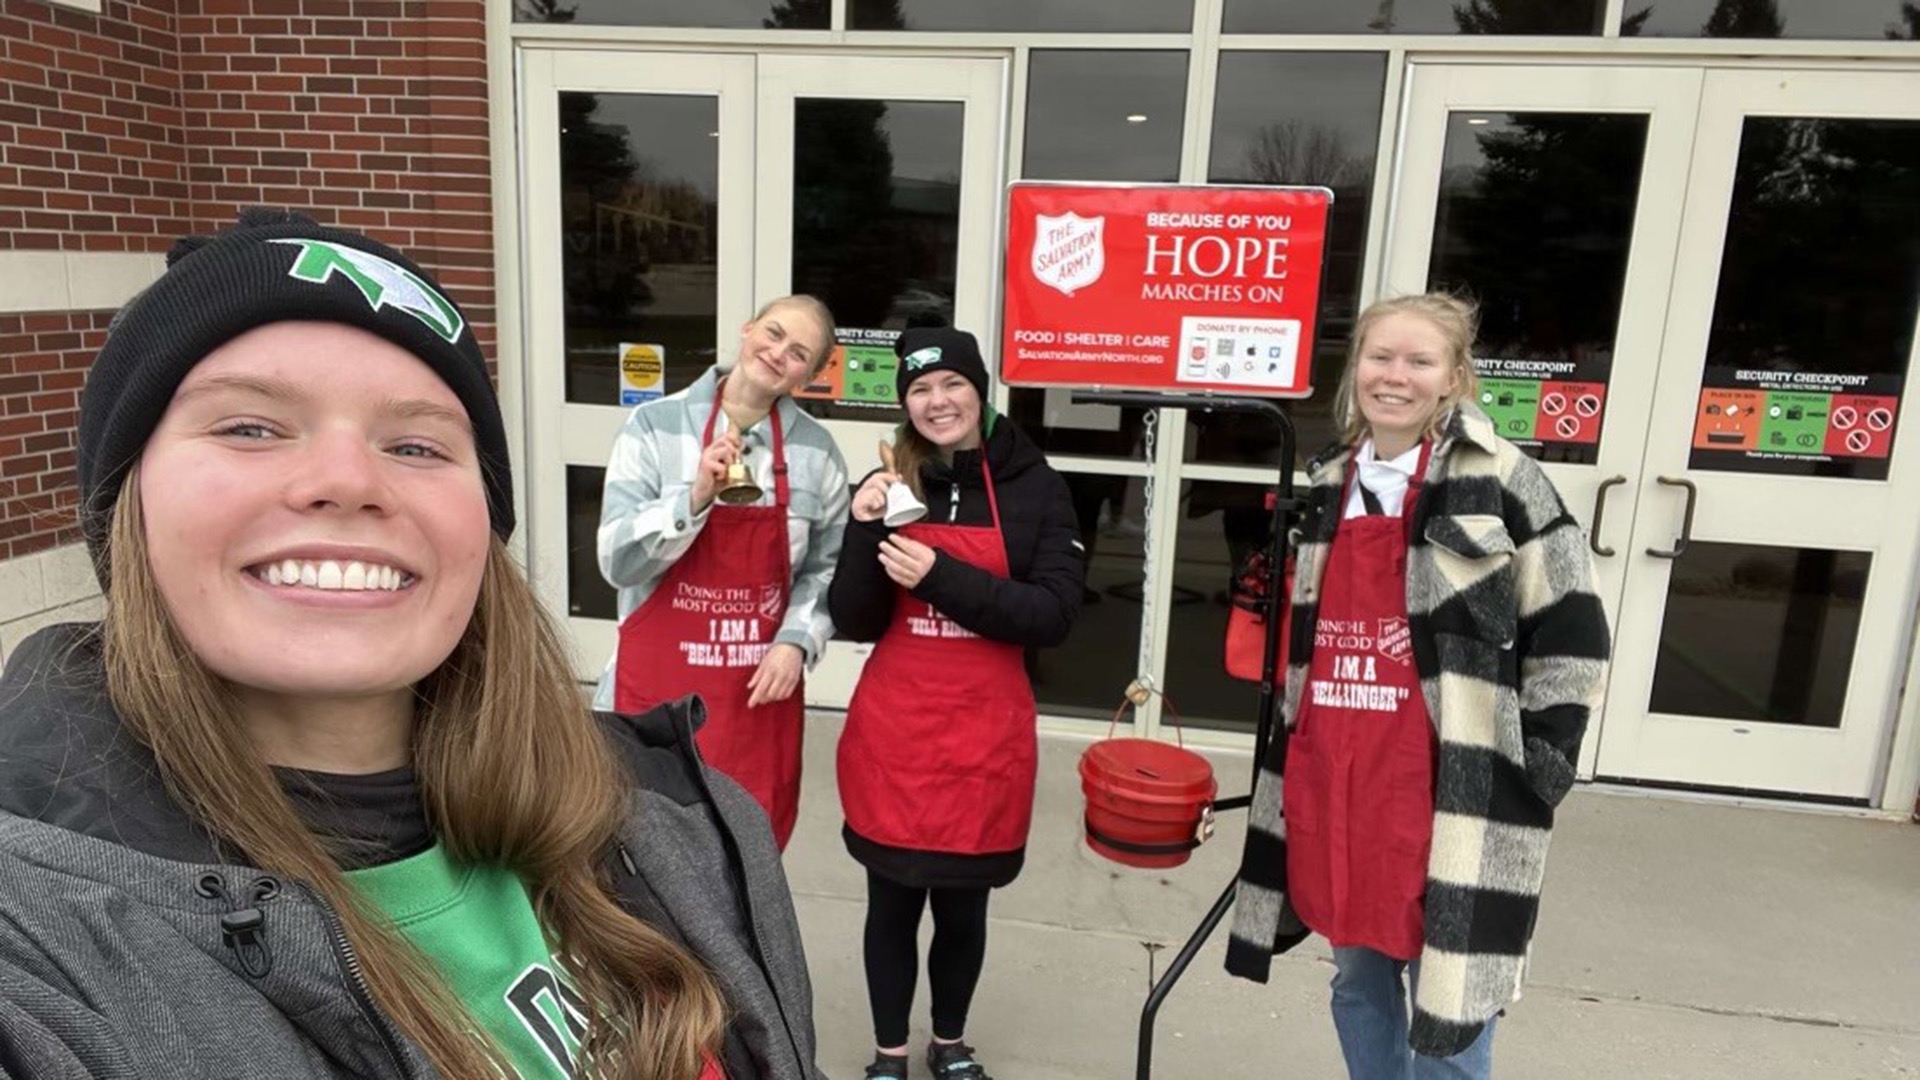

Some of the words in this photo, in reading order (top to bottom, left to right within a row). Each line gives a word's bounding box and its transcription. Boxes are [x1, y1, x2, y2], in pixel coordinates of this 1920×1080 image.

[1147, 212, 1224, 228] BECAUSE
[1227, 214, 1251, 229] OF
[1255, 215, 1291, 230] YOU
[1048, 220, 1074, 246] THE
[1037, 225, 1097, 272] SALVATION
[1143, 234, 1289, 279] HOPE
[1057, 247, 1095, 283] ARMY
[1141, 282, 1243, 302] MARCHES
[1248, 285, 1284, 303] ON
[834, 327, 863, 338] URITY
[1197, 323, 1236, 333] DONATE
[1238, 325, 1250, 333] BY
[1253, 326, 1287, 335] PHONE
[1014, 330, 1055, 344] FOOD
[1064, 332, 1123, 346] SHELTER
[1132, 334, 1170, 348] CARE
[1504, 360, 1576, 373] CHECKPOINT
[1735, 370, 1792, 382] SECURITY
[1793, 373, 1869, 386] CHECKPOINT
[678, 582, 722, 599] DOING
[725, 588, 751, 600] THE
[672, 597, 709, 612] MOST
[709, 619, 717, 641] I
[720, 619, 745, 642] AM
[749, 619, 759, 642] A
[1363, 656, 1376, 682] A
